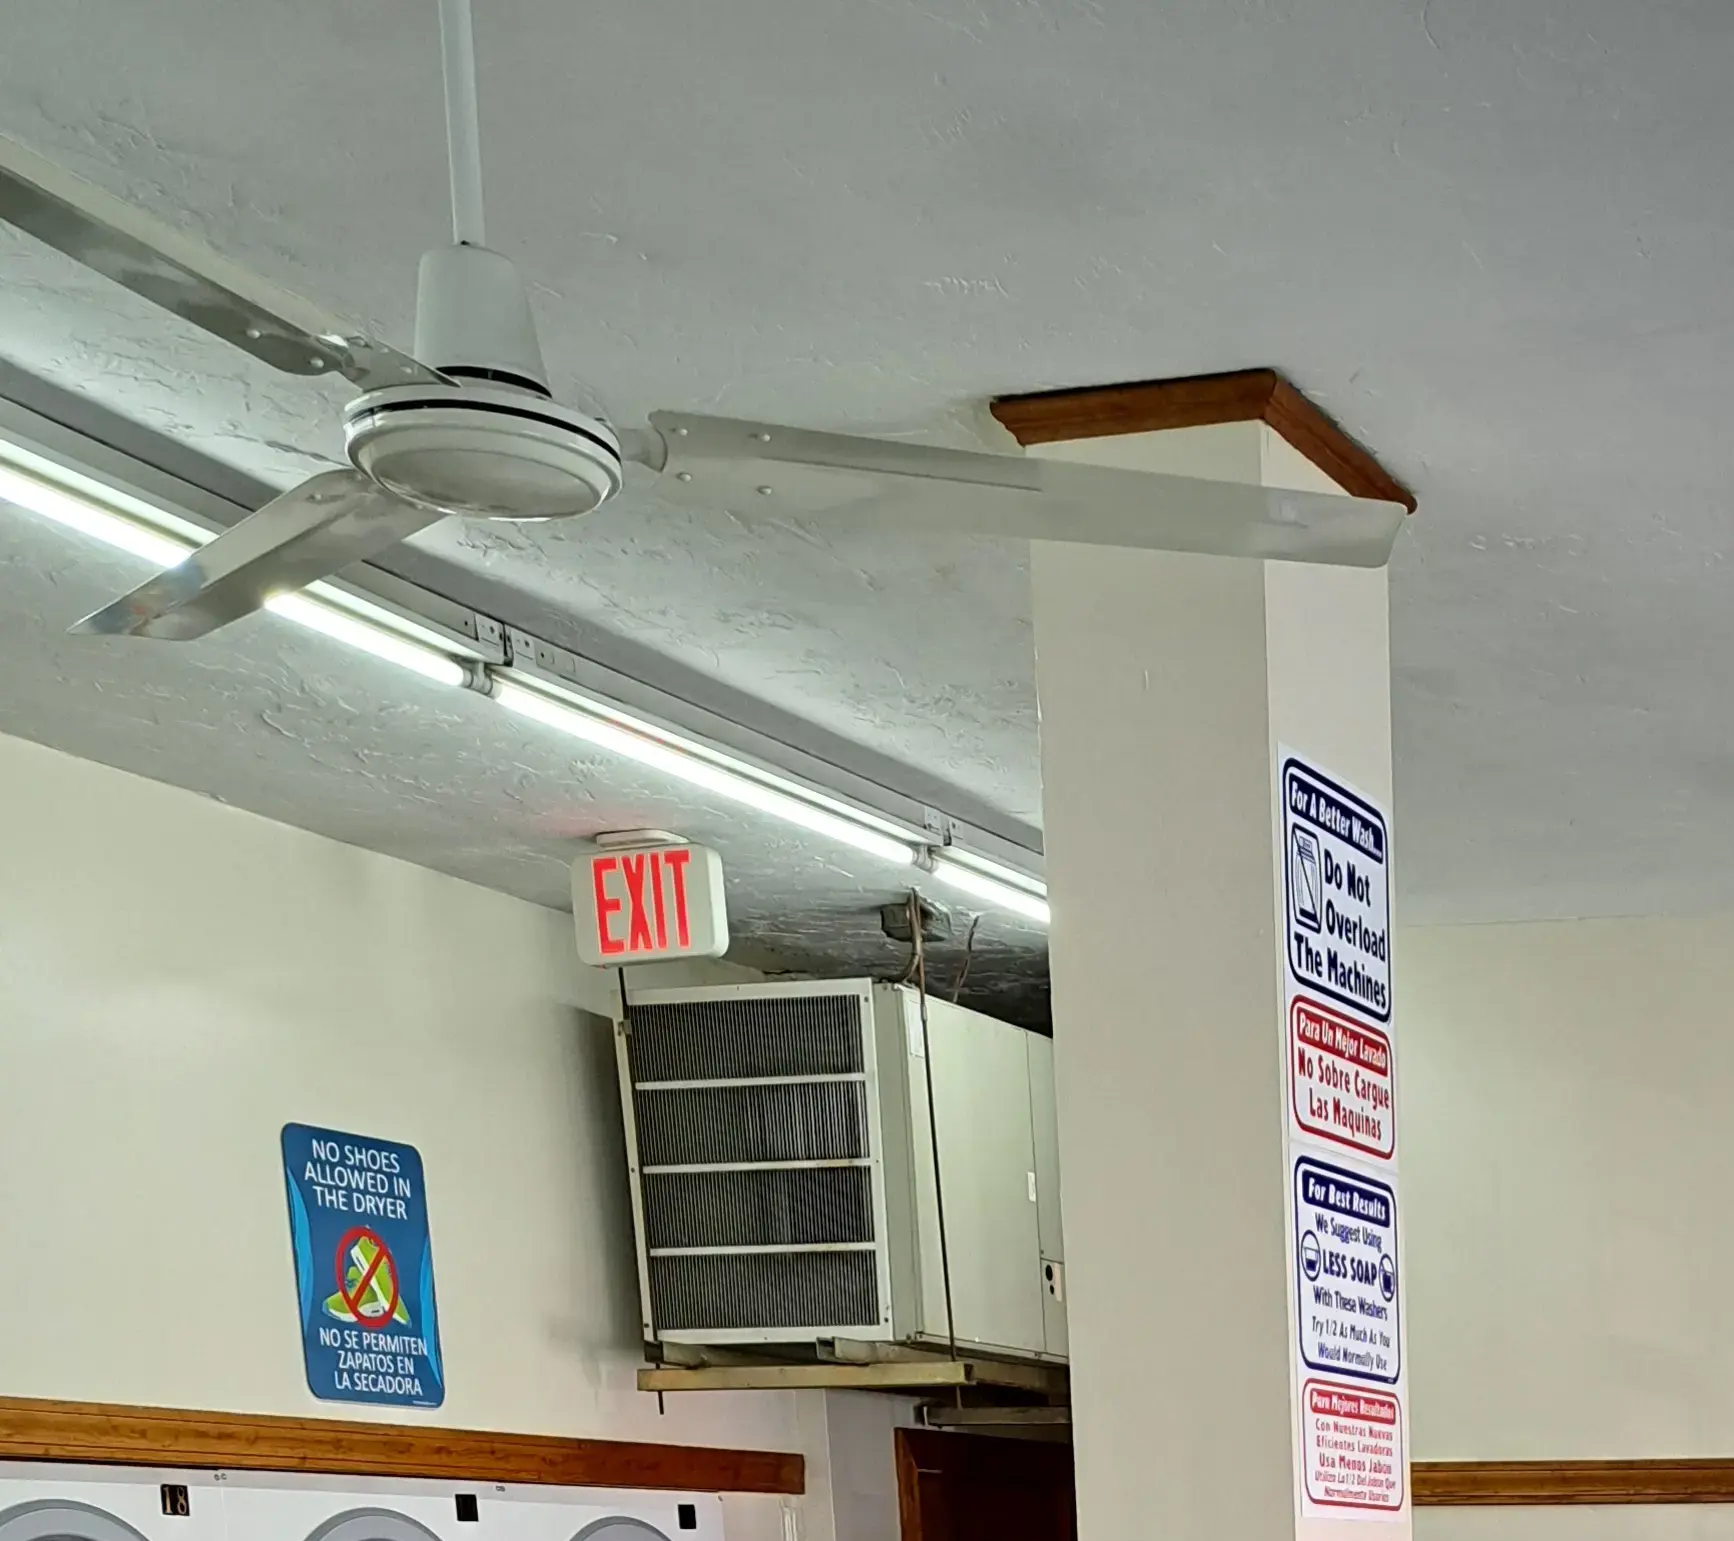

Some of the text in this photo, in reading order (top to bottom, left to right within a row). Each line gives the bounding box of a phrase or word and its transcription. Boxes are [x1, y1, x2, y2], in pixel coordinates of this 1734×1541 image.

[1291, 780, 1309, 810] For
[1309, 797, 1317, 821] A
[1318, 798, 1351, 838] Better
[1324, 848, 1371, 907] Do Not
[592, 849, 690, 956] EXIT
[1325, 905, 1386, 962] Overload
[1294, 931, 1386, 1010] The Machines
[1299, 1014, 1386, 1069] Para Un Mejor Lavado
[1298, 1046, 1389, 1111] No Sobre Cargue
[1309, 1088, 1382, 1141] Las Maquinas
[312, 1139, 400, 1173] NO SHOES
[304, 1161, 411, 1198] ALLOWED IN
[313, 1186, 408, 1220] THE DRYER
[1308, 1178, 1386, 1221] For Best Results
[1315, 1212, 1382, 1254] We Suggest Using
[1322, 1249, 1377, 1286] LESS SOAP
[1313, 1285, 1388, 1321] With These Washers
[320, 1327, 428, 1356] NO SE PERMITEN
[1312, 1315, 1390, 1348] Try 1/2 As Much As You
[338, 1350, 414, 1375] ZAPATOS EN
[1318, 1341, 1387, 1371] Would Normally Use
[334, 1370, 423, 1396] LA SECADORA
[1312, 1391, 1330, 1409] Para
[1316, 1418, 1393, 1441] Con Nuestras Nuevas
[1316, 1435, 1392, 1456] Eficientes Lavadoras
[1319, 1452, 1335, 1468] Usa
[1339, 1454, 1366, 1472] Menos
[163, 1487, 187, 1514] 18
